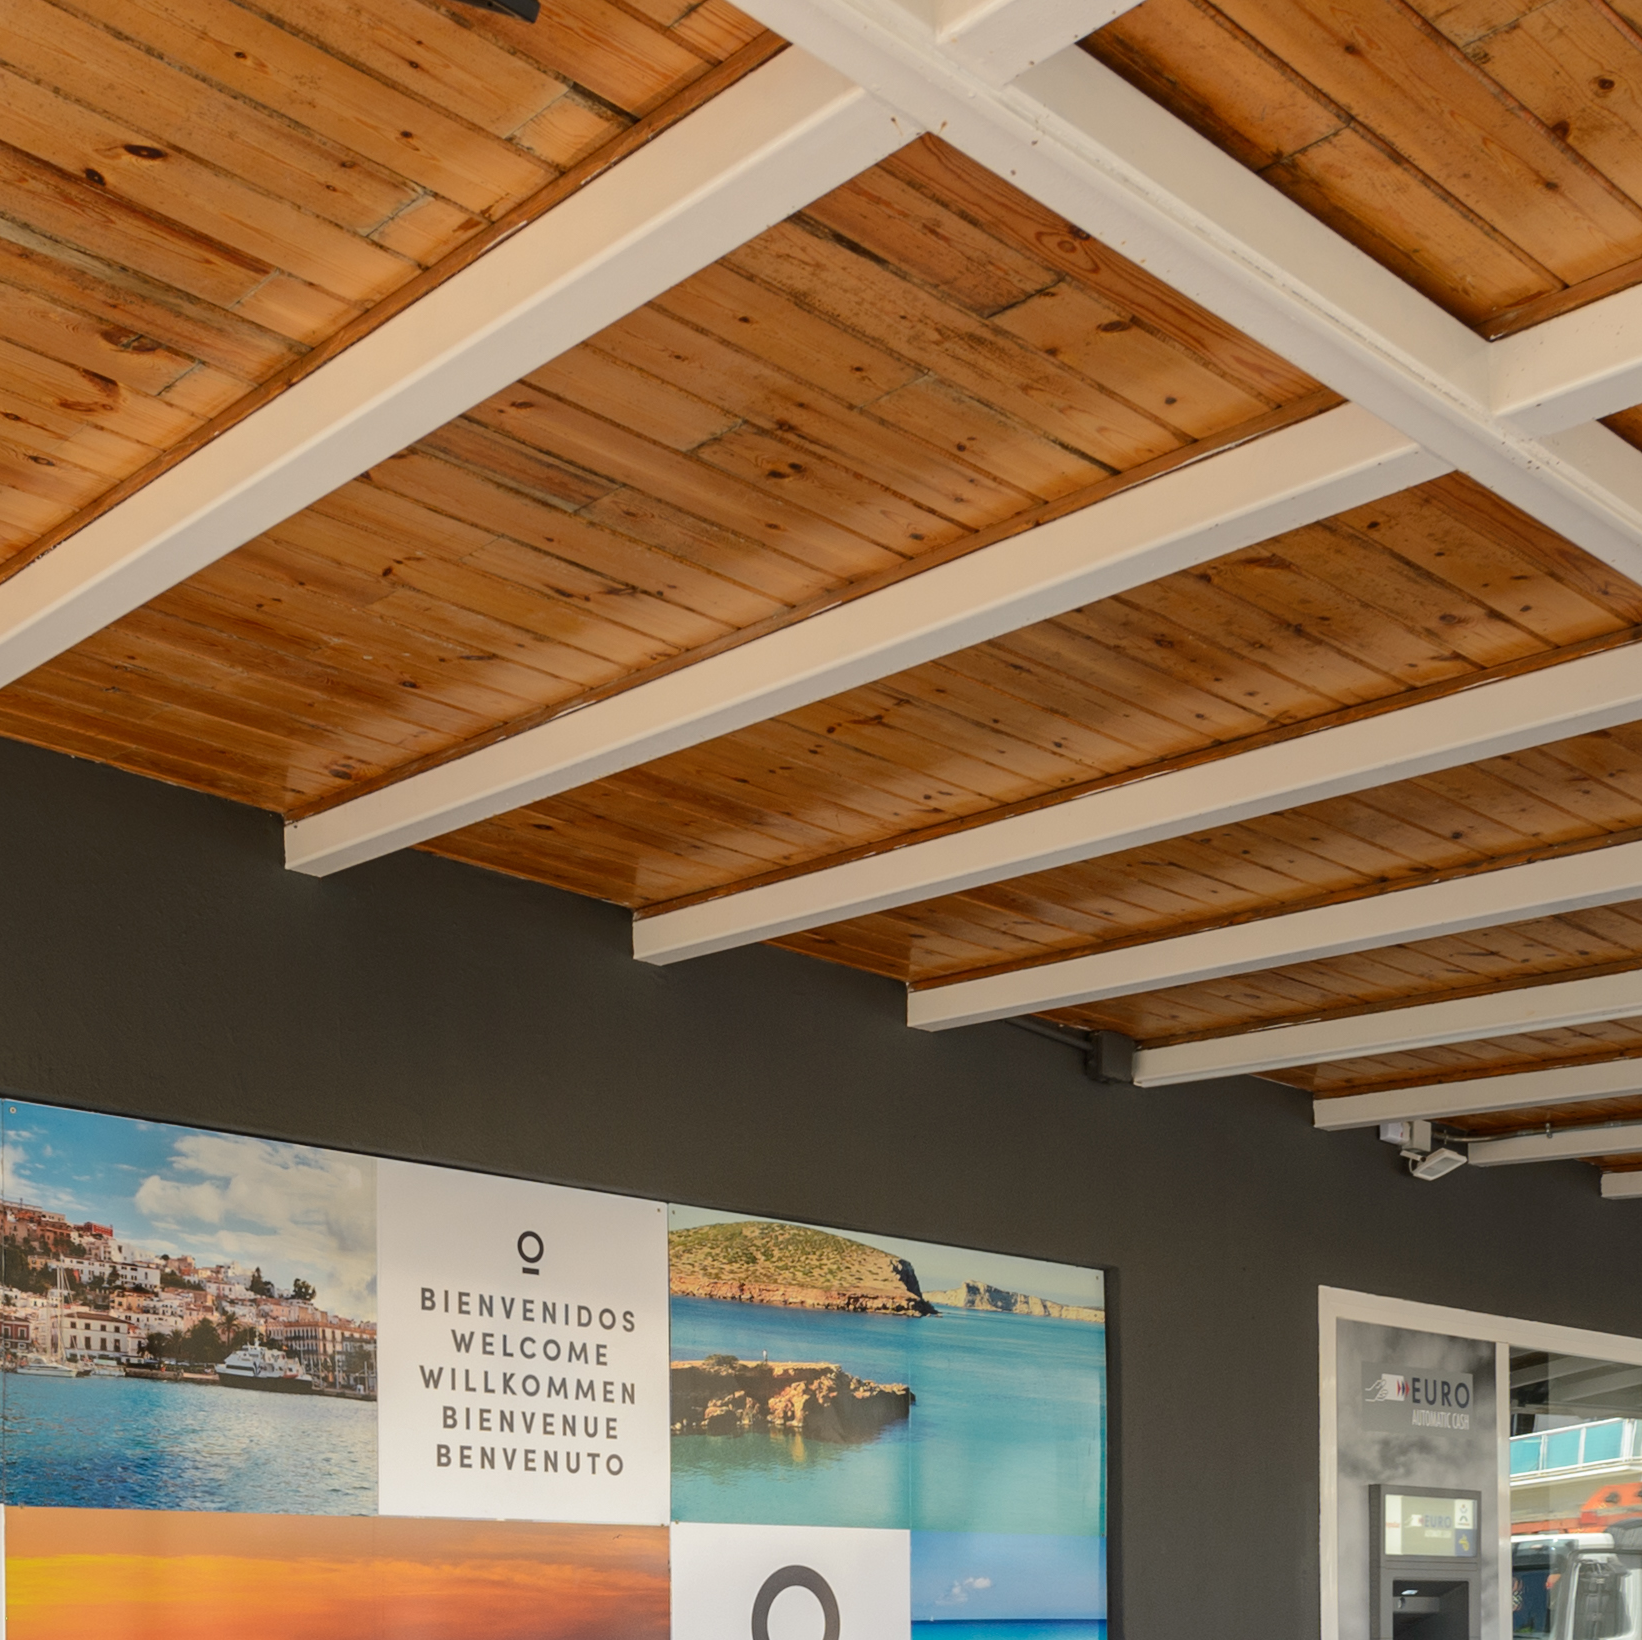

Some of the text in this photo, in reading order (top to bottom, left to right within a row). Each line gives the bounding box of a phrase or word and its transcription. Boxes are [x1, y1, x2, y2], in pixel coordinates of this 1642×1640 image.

[420, 1287, 635, 1333] BIENVENIDOS
[451, 1329, 608, 1366] WELCOME
[419, 1364, 635, 1405] WILLKOMMEN
[1411, 1377, 1470, 1409] EURO
[442, 1405, 618, 1440] BIENVENUE
[1412, 1409, 1470, 1430] AUTOMATIC CASH
[436, 1443, 624, 1476] BENVENUTO
[1424, 1515, 1452, 1528] EURO
